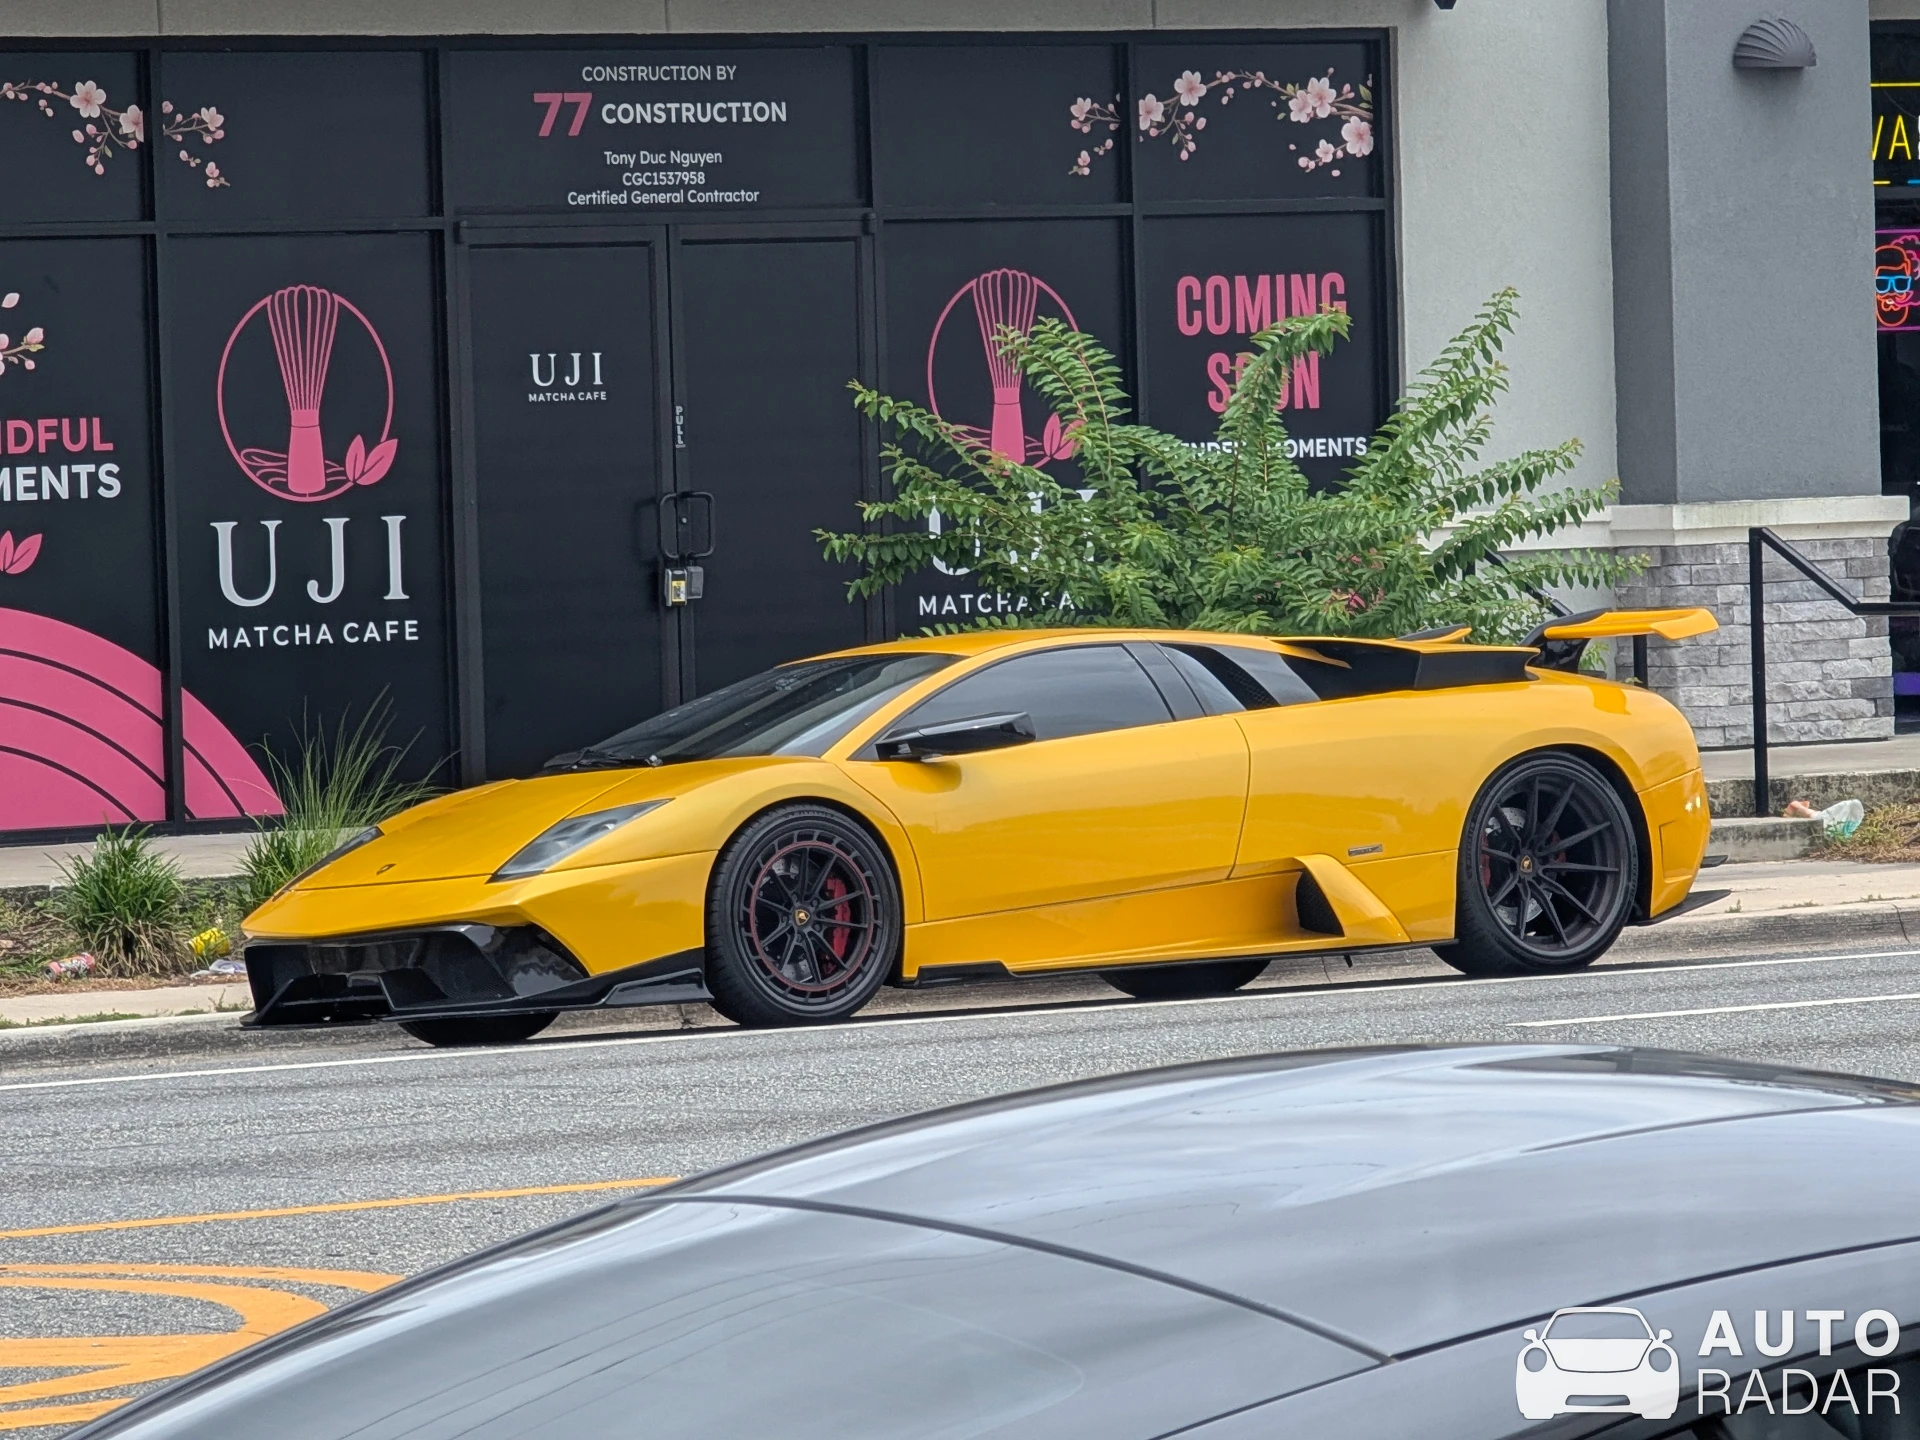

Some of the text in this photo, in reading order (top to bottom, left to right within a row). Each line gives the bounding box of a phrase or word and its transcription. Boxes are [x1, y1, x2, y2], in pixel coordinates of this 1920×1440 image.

[582, 65, 737, 82] CONSTRUCTION BY
[534, 92, 787, 137] 77 CONSTRUCTION
[603, 150, 723, 169] Tony Duc Nguyen
[622, 171, 706, 186] CGC1537958
[567, 189, 760, 206] Certified General Contractor
[1176, 272, 1347, 337] COMING
[529, 352, 603, 387] UJI
[1206, 350, 1320, 413] SN
[528, 391, 607, 403] MATCHA CAFE
[0, 417, 114, 455] DFUL
[675, 405, 684, 445] PULL
[209, 515, 410, 607] UJI
[208, 619, 419, 650] MATCHA CAFE
